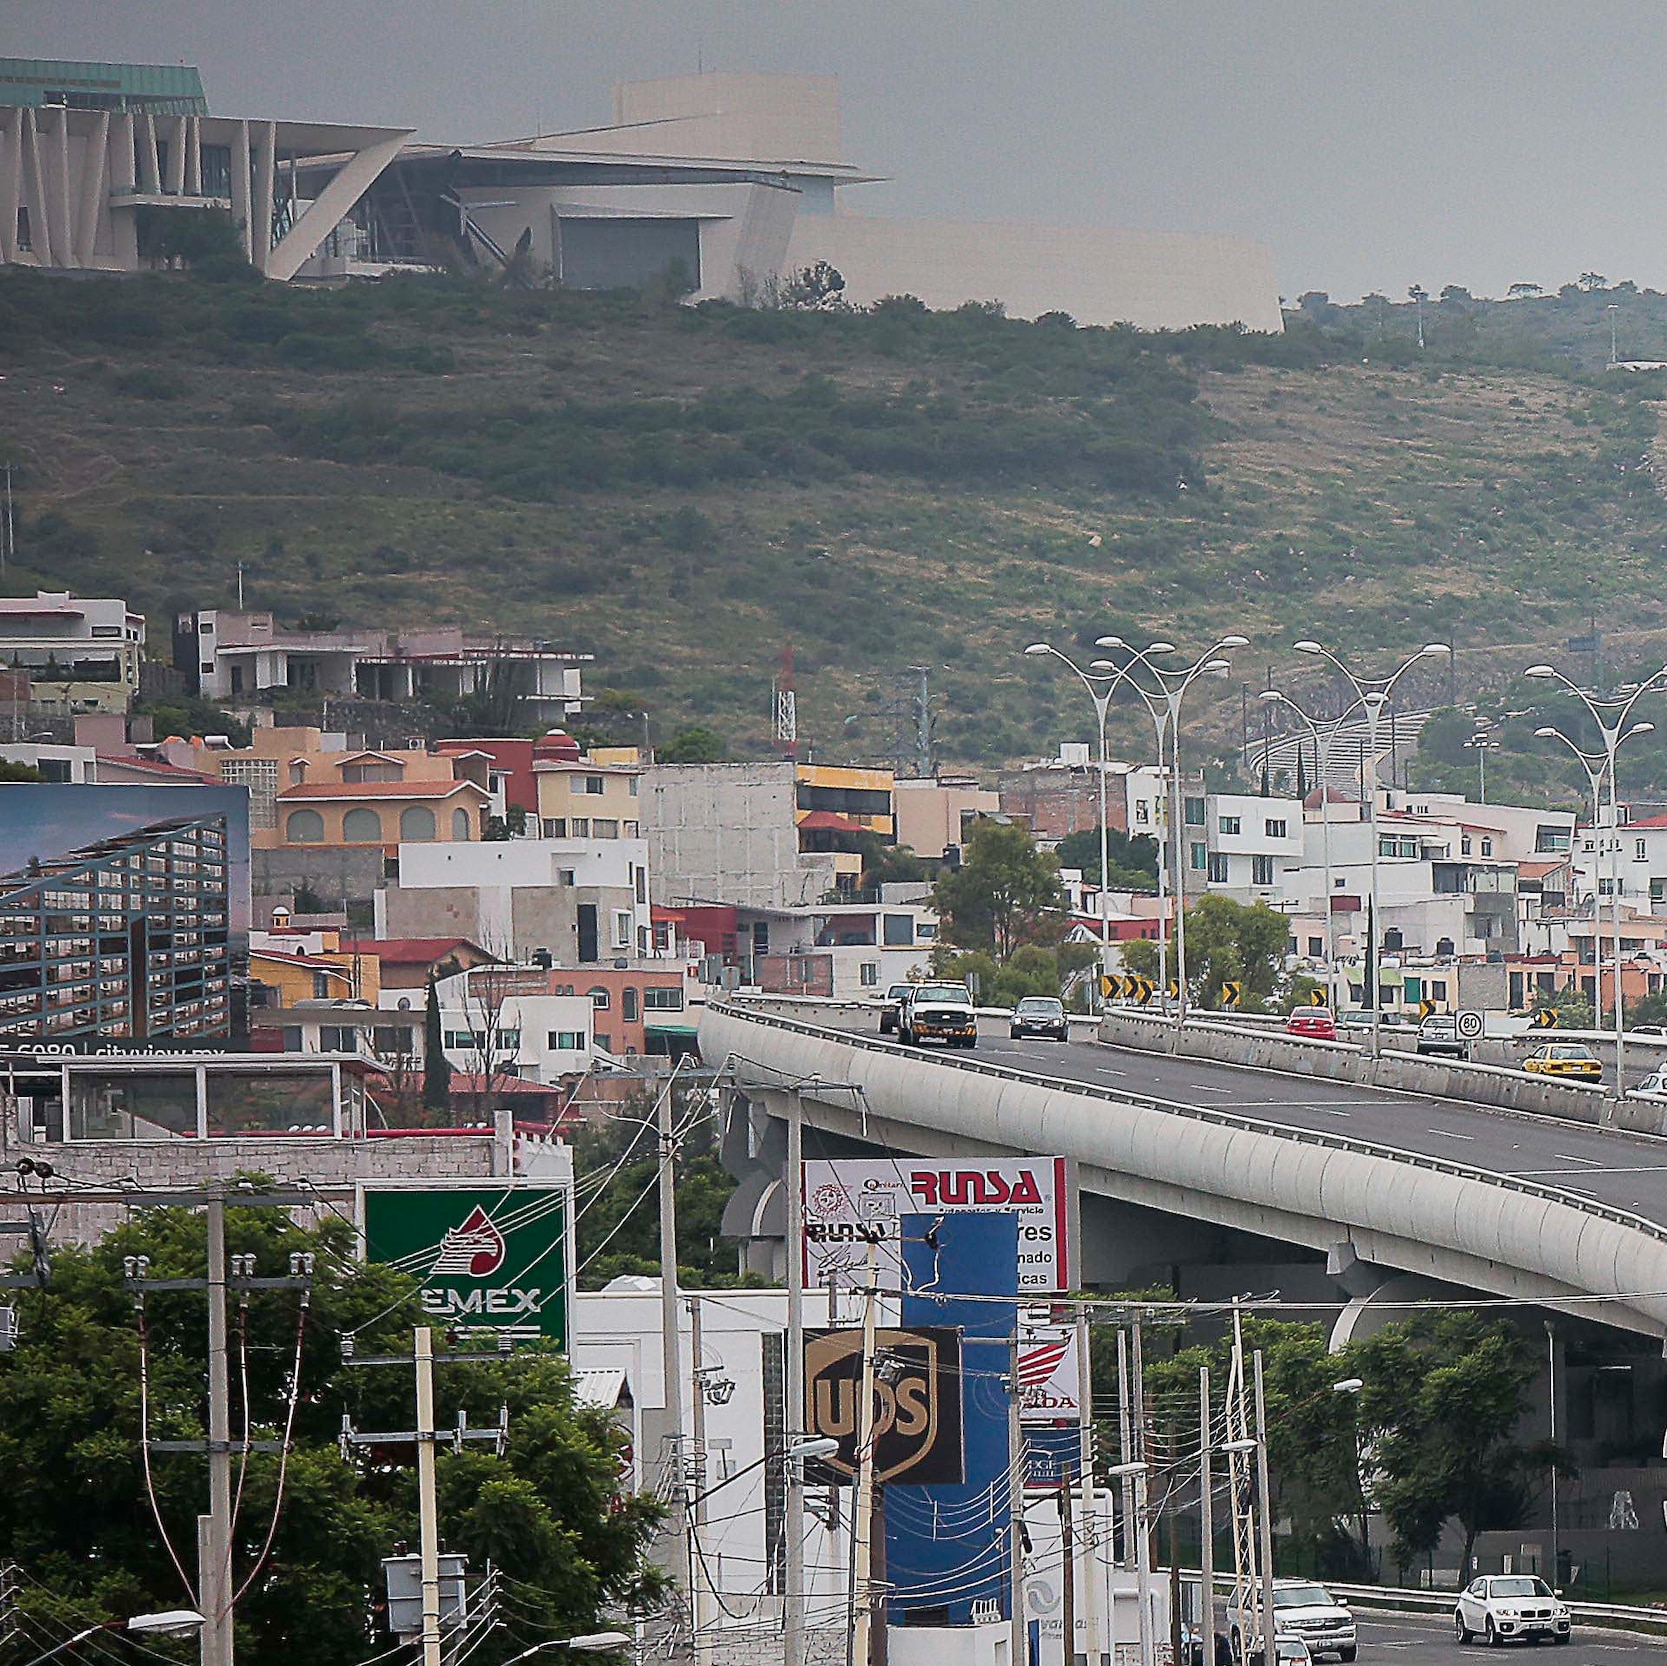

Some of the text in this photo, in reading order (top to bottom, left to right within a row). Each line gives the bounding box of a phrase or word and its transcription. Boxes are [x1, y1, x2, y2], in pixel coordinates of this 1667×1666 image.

[1464, 1016, 1476, 1028] 80
[911, 1170, 1043, 1205] RUNSA
[1017, 1225, 1053, 1242] res
[1017, 1251, 1053, 1264] nado
[1018, 1271, 1048, 1285] icas
[420, 1288, 542, 1314] EMEX
